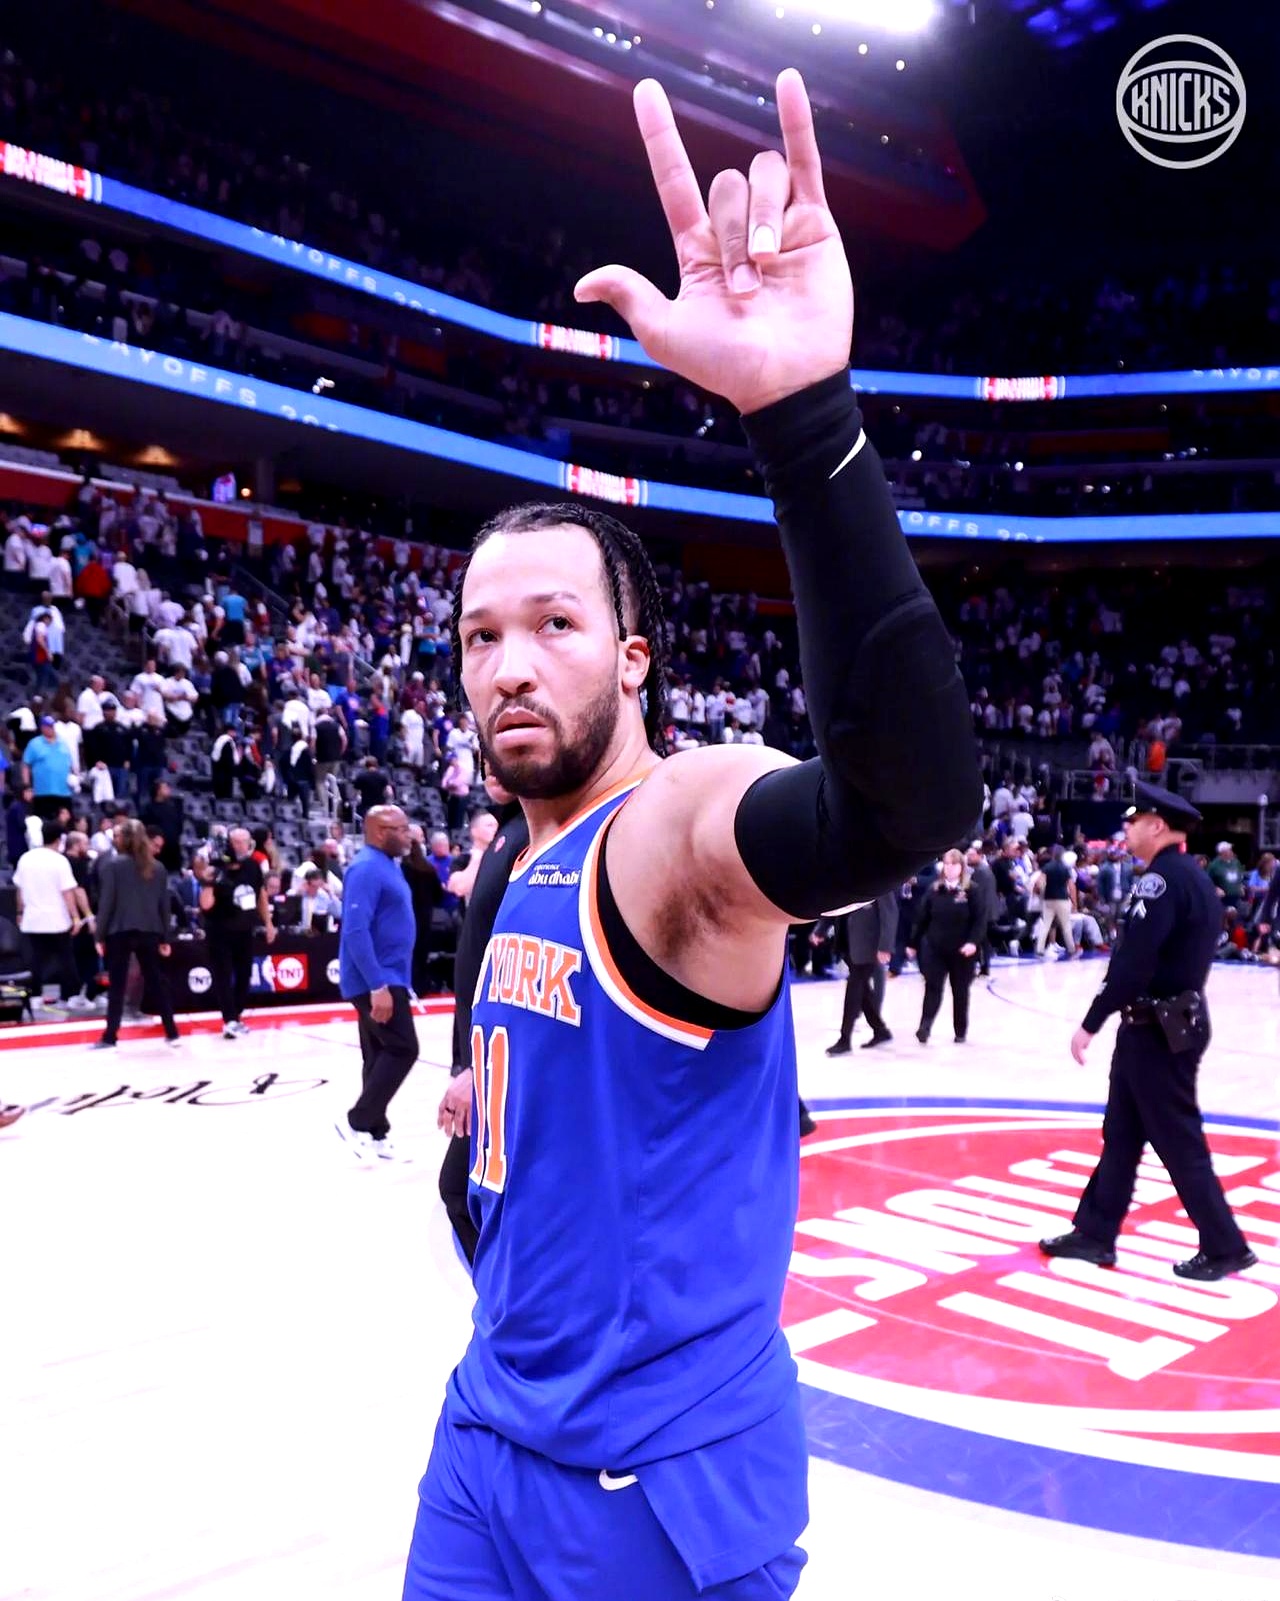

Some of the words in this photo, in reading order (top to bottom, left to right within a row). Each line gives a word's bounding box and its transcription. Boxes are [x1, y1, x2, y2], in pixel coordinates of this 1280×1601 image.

[528, 871, 549, 886] abu
[488, 932, 583, 1028] YORK
[469, 1025, 510, 1194] 11
